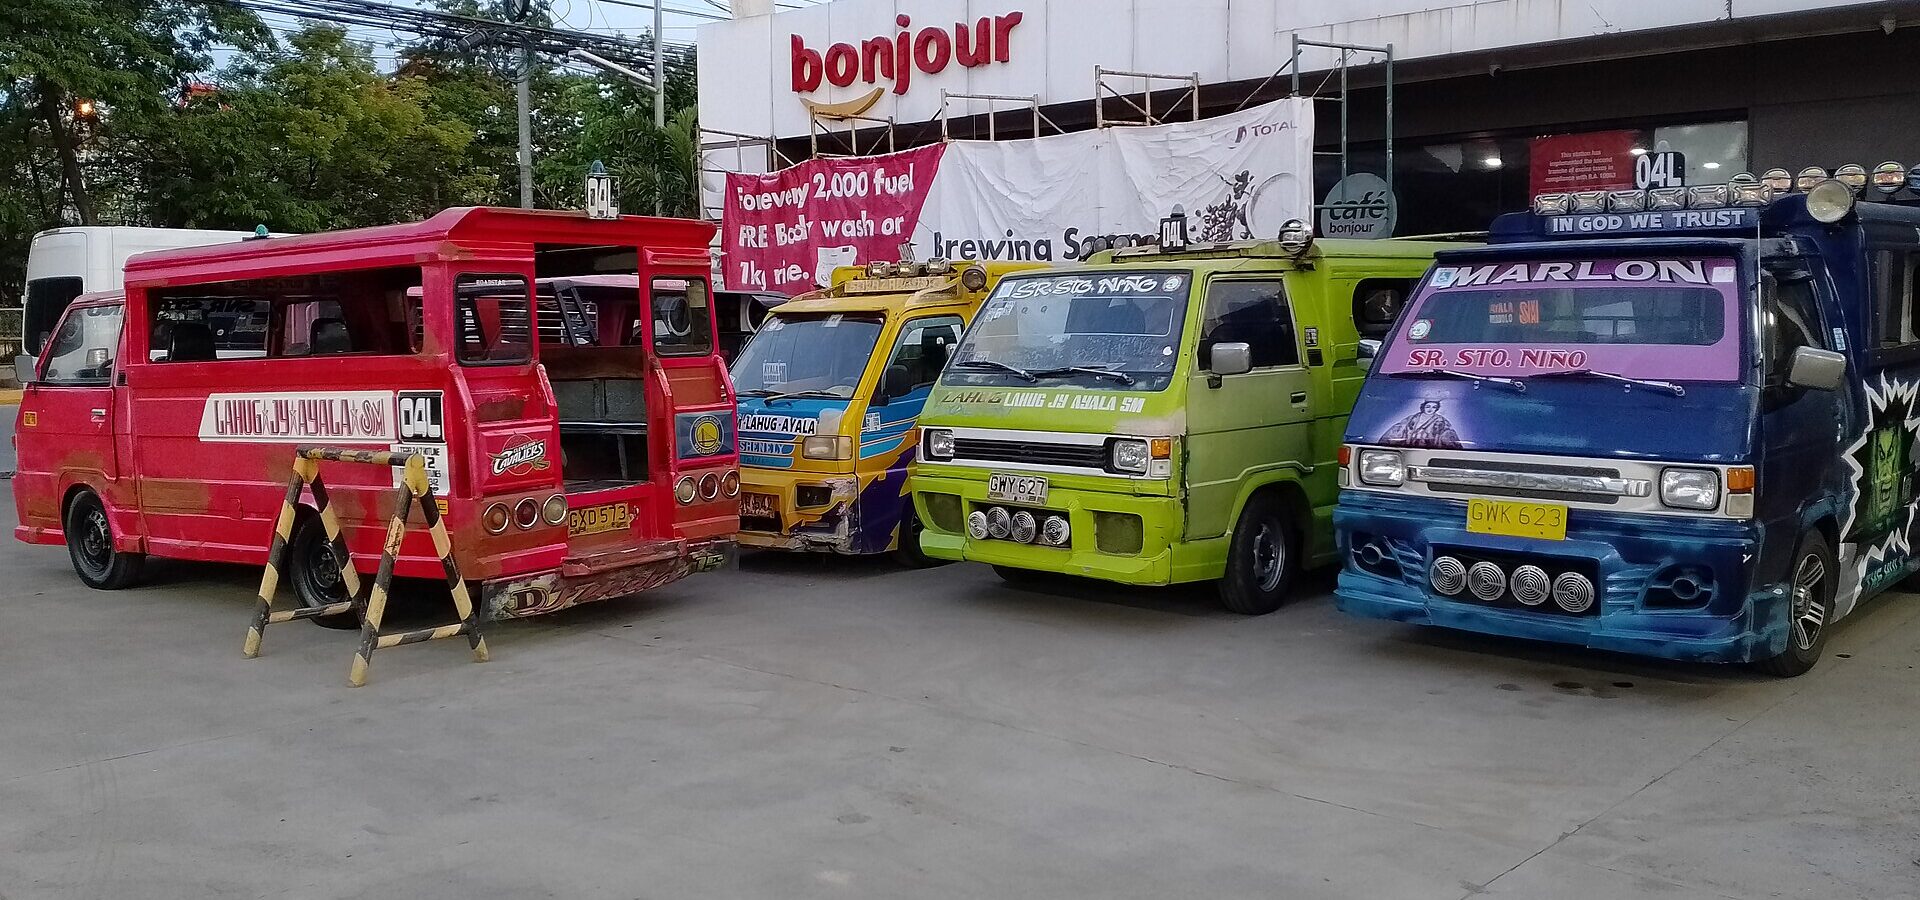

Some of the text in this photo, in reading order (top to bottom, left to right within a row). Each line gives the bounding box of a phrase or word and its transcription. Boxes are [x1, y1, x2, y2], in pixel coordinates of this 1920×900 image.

[790, 11, 1023, 95] bonjour
[1252, 120, 1297, 136] TOTAL
[813, 171, 869, 202] 2,000
[873, 163, 914, 195] fuel
[1636, 153, 1682, 189] 04L
[1329, 191, 1387, 220] café
[821, 210, 874, 238] wash
[881, 215, 904, 236] or
[1162, 220, 1184, 247] 04L
[1329, 222, 1374, 236] bonjour
[1553, 210, 1746, 233] IN GOD WE TRUST
[1441, 259, 1712, 289] MARLON
[1407, 349, 1448, 368] SR.
[1455, 349, 1511, 368] STO.
[1003, 392, 1046, 407] LAHUG
[1048, 394, 1067, 409] JY
[1071, 395, 1116, 411] AYALA
[1119, 397, 1146, 413] SM
[214, 399, 264, 436] LAHUG
[299, 399, 351, 437] AYALA
[360, 398, 387, 437] SM
[400, 397, 442, 439] 04L
[745, 415, 778, 431] LAHUG
[781, 417, 816, 435] AYALA
[493, 442, 544, 474] CAVALIERS
[991, 476, 1045, 496] GWY 627
[570, 505, 626, 528] GXD 573
[1472, 502, 1561, 527] GWK 623
